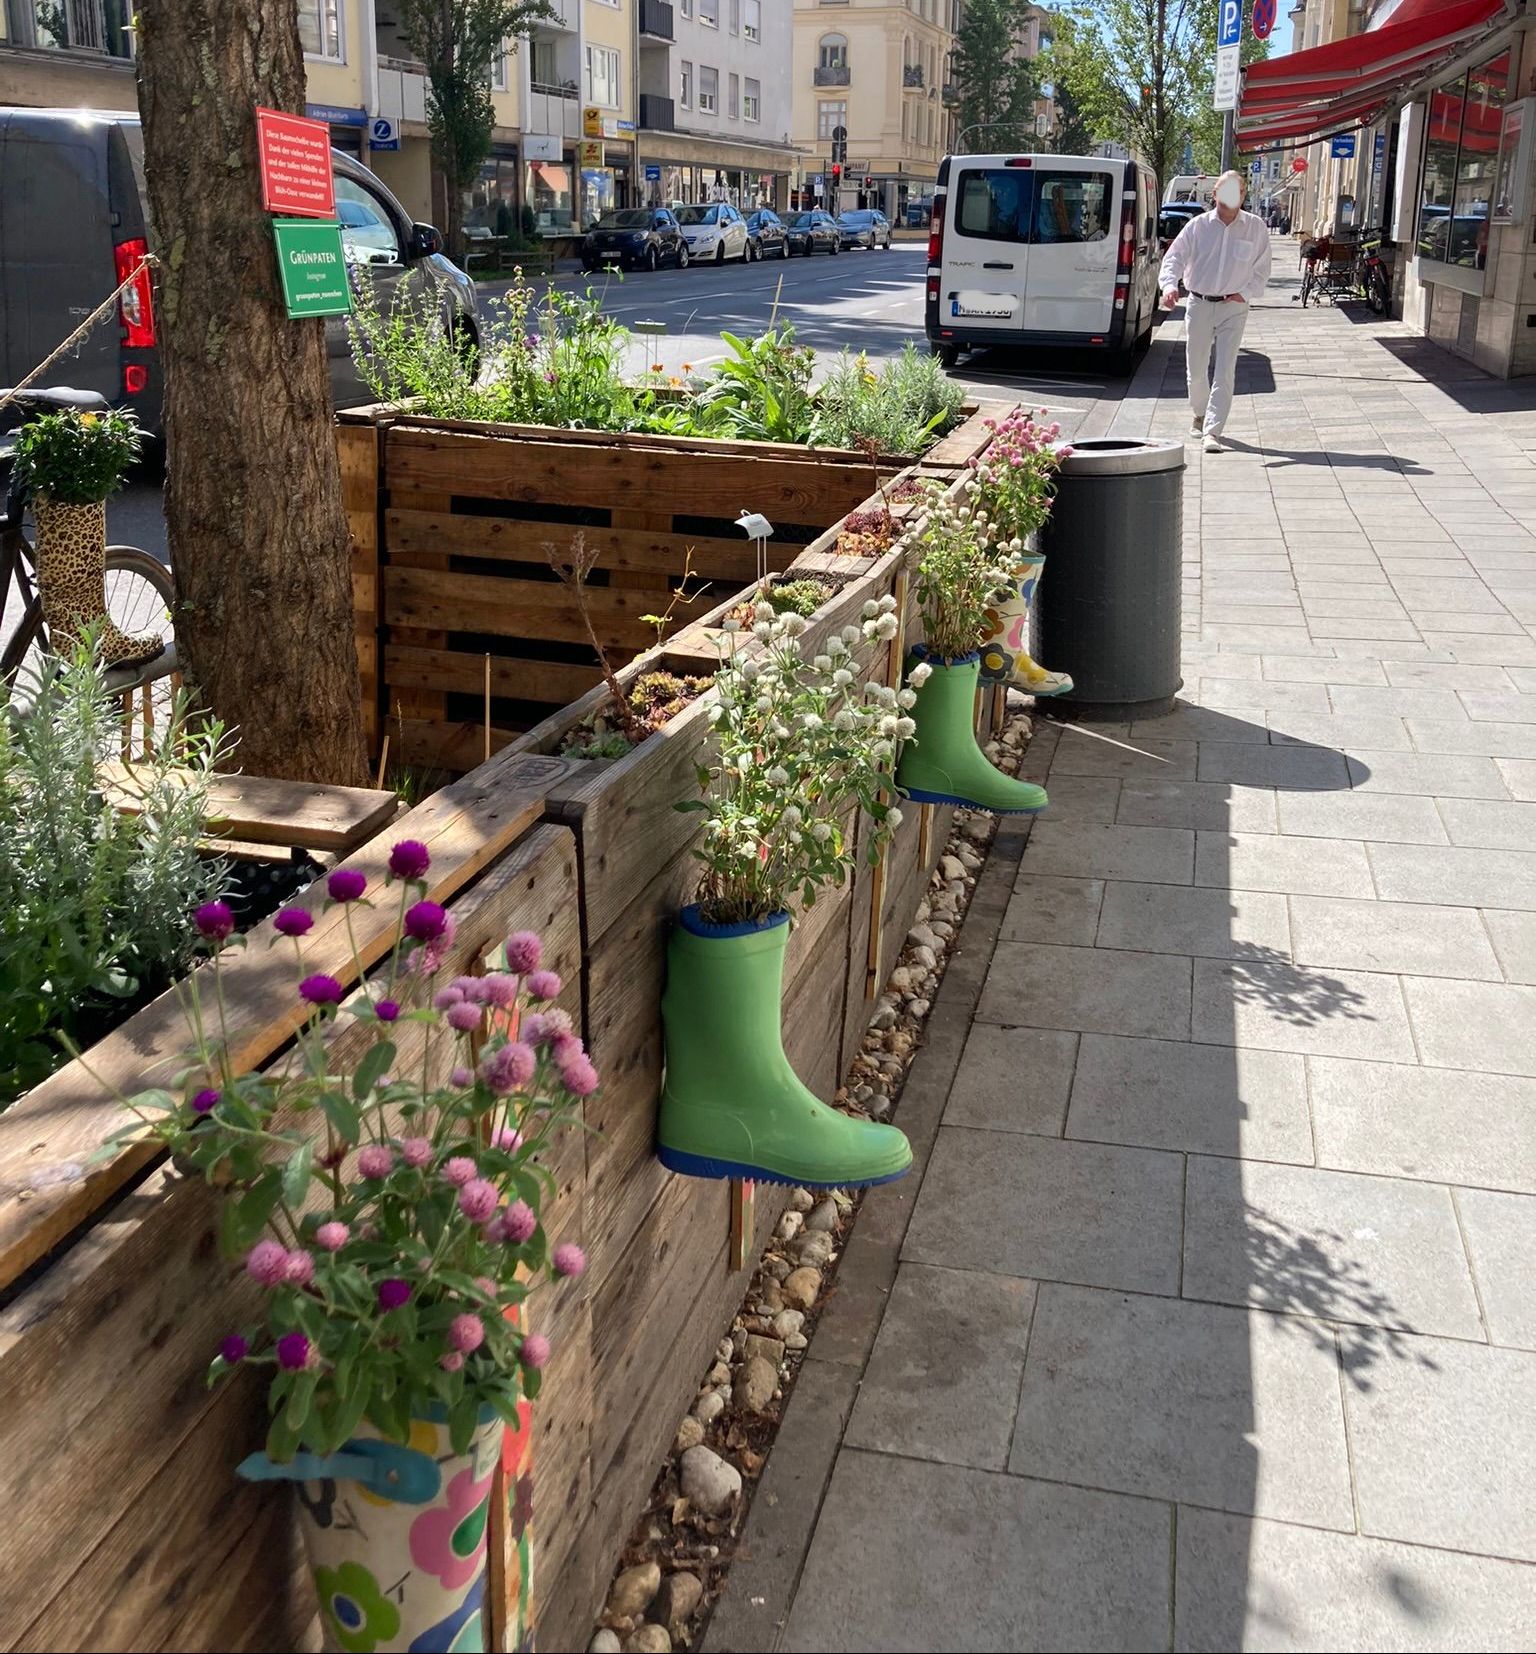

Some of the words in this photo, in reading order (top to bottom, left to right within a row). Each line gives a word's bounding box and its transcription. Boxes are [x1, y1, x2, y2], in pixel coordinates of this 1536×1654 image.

[1223, 1, 1237, 40] P
[376, 123, 388, 138] Z
[268, 144, 281, 152] Dank
[305, 152, 324, 162] Spenden
